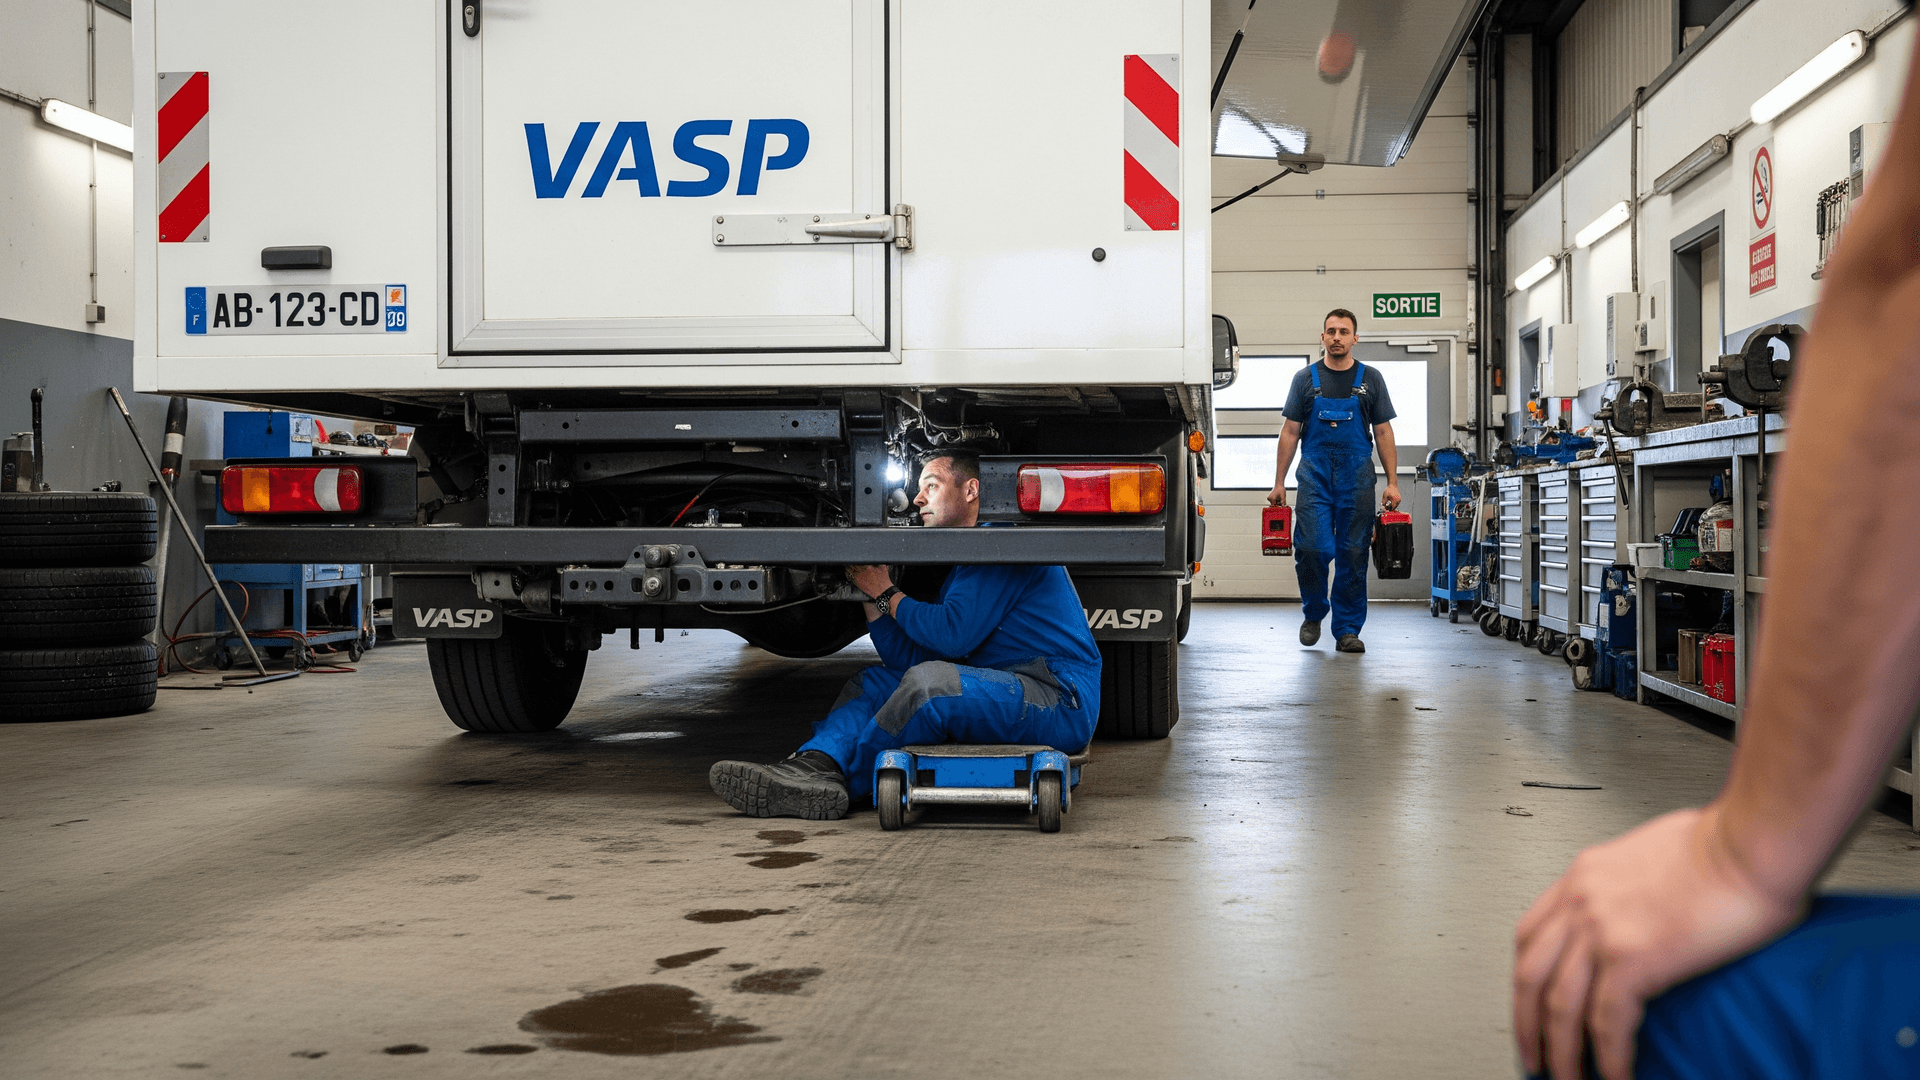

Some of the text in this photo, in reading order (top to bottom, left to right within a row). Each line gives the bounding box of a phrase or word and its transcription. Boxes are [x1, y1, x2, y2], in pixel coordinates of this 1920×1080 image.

[524, 118, 810, 199] VASP
[192, 314, 200, 325] F
[213, 291, 379, 328] AB-123-CD
[1375, 297, 1437, 314] SORTIE
[412, 607, 494, 628] VASP
